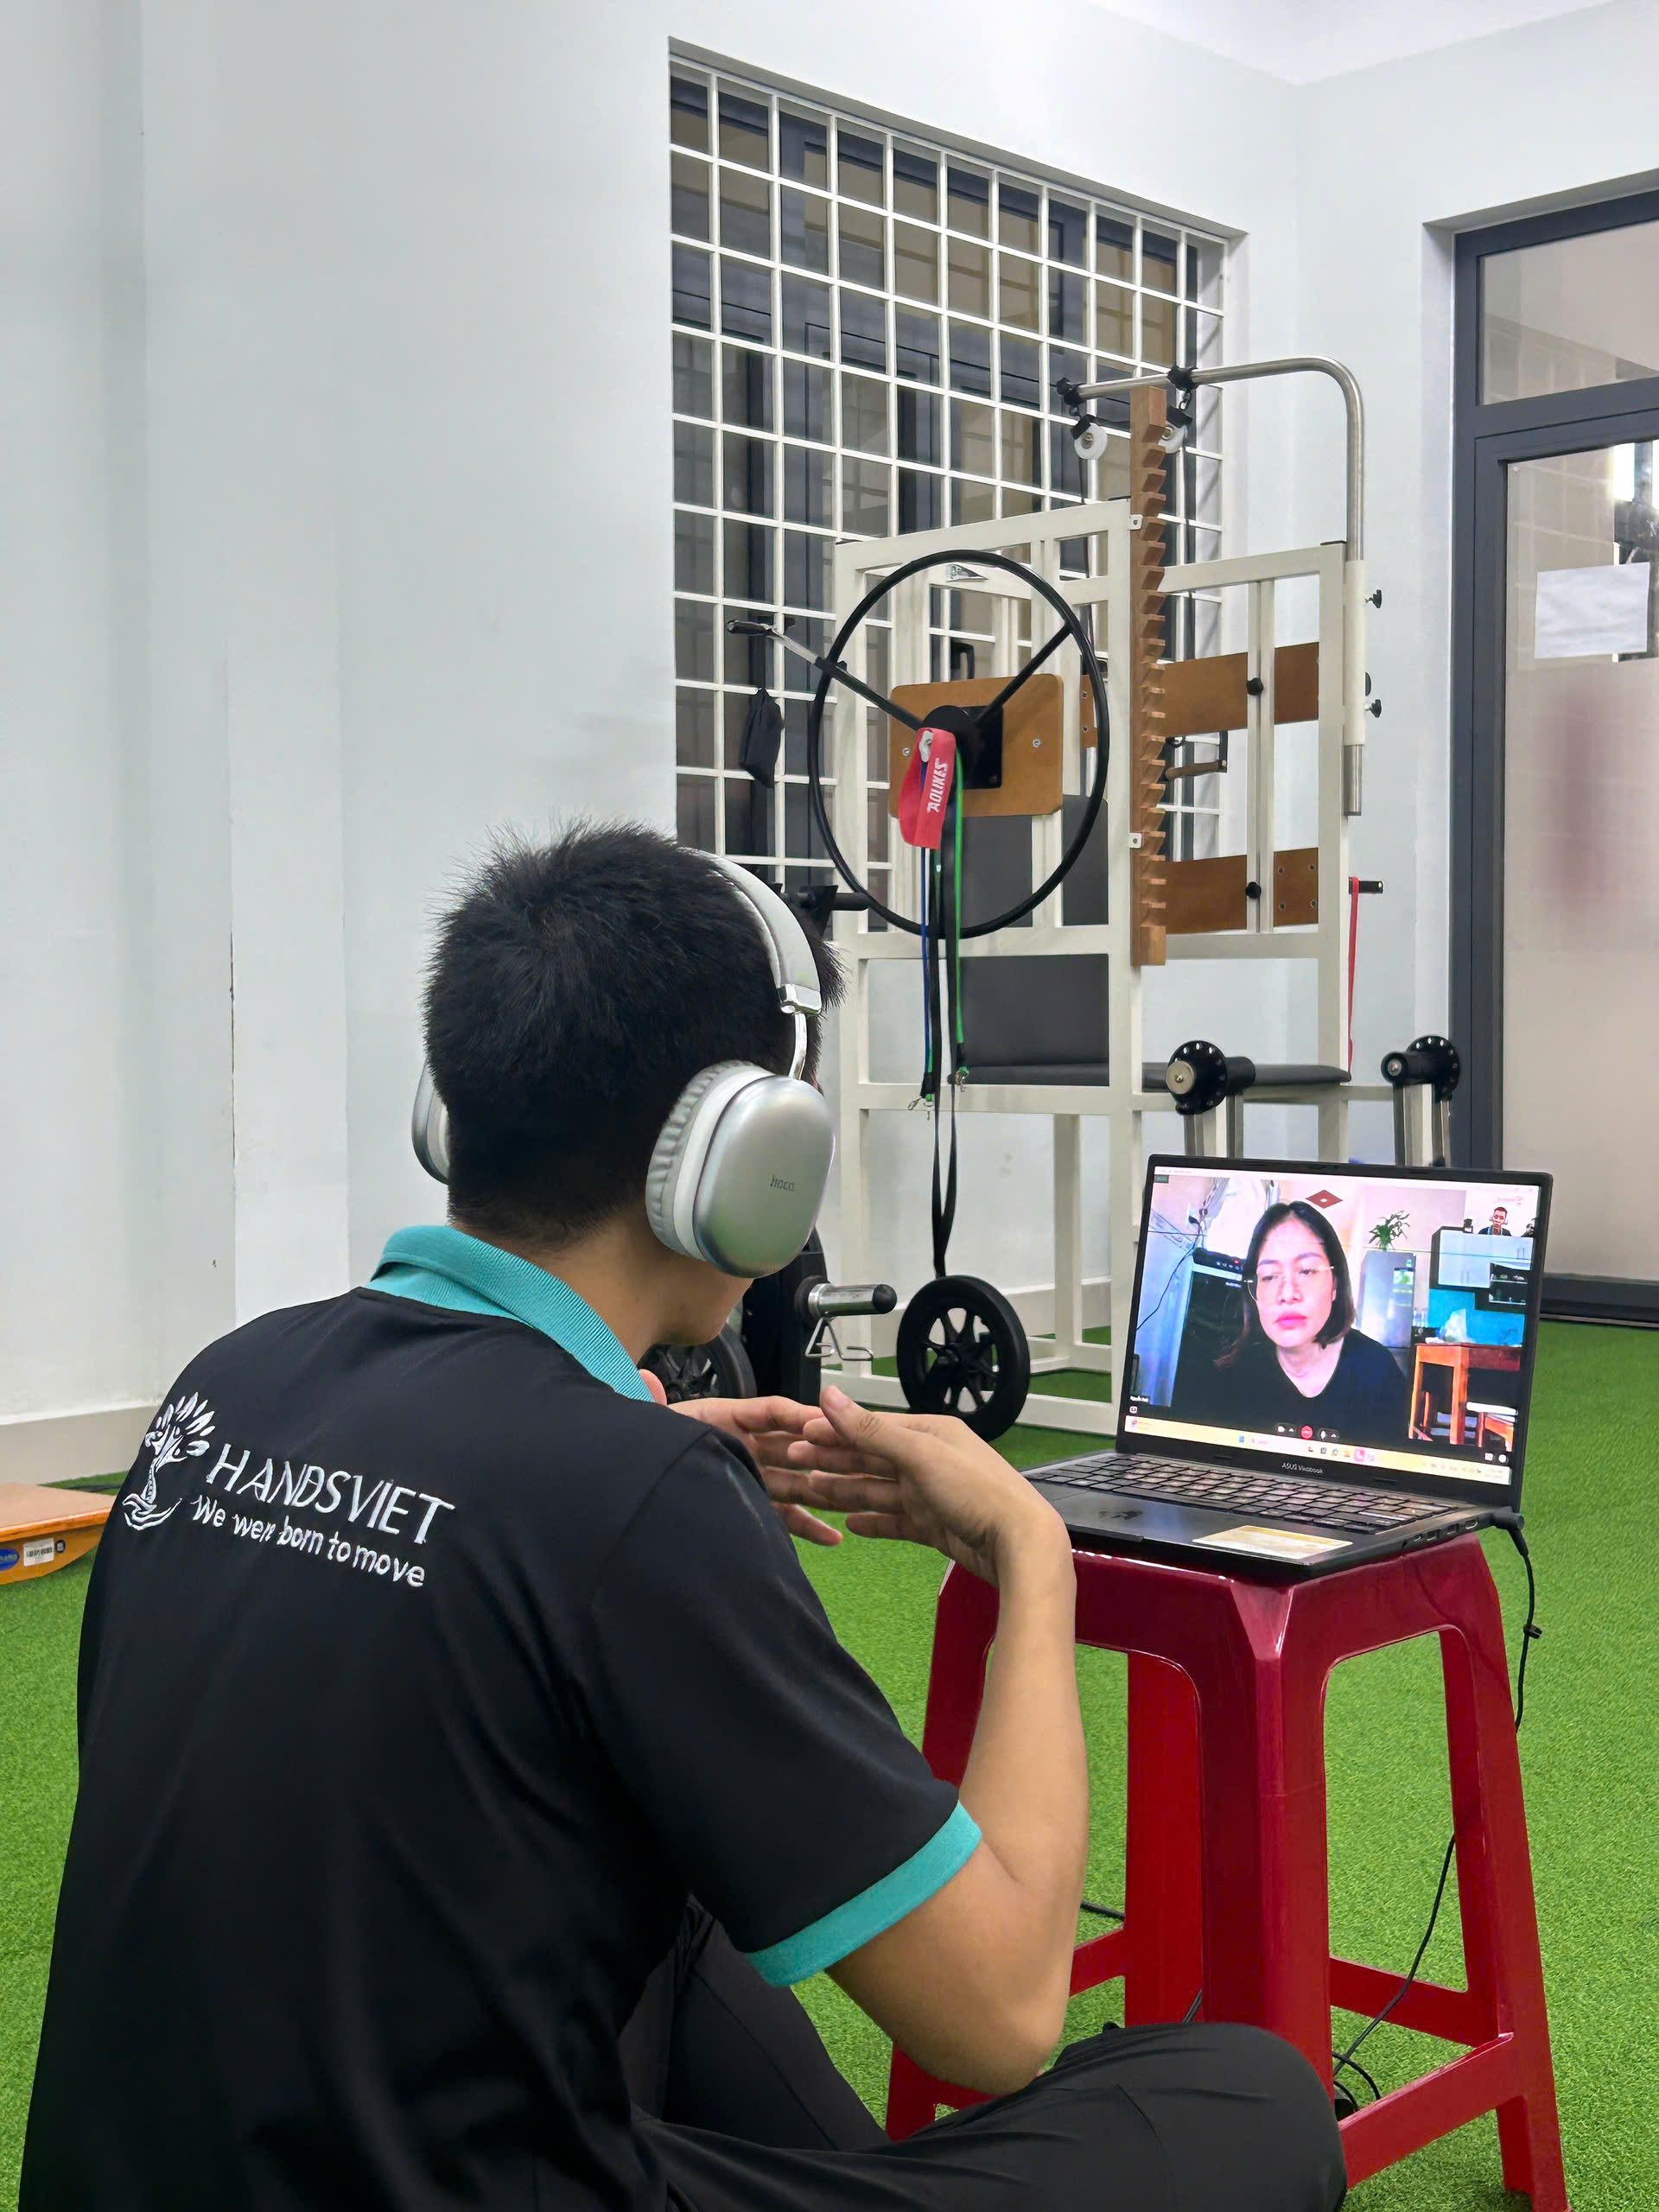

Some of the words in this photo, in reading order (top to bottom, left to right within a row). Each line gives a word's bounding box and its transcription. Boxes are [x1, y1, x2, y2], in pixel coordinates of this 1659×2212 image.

[189, 1494, 226, 1528] We
[276, 1515, 325, 1555] born
[327, 1530, 351, 1562] to
[353, 1545, 425, 1587] move
[206, 1443, 456, 1545] HANDSVIET
